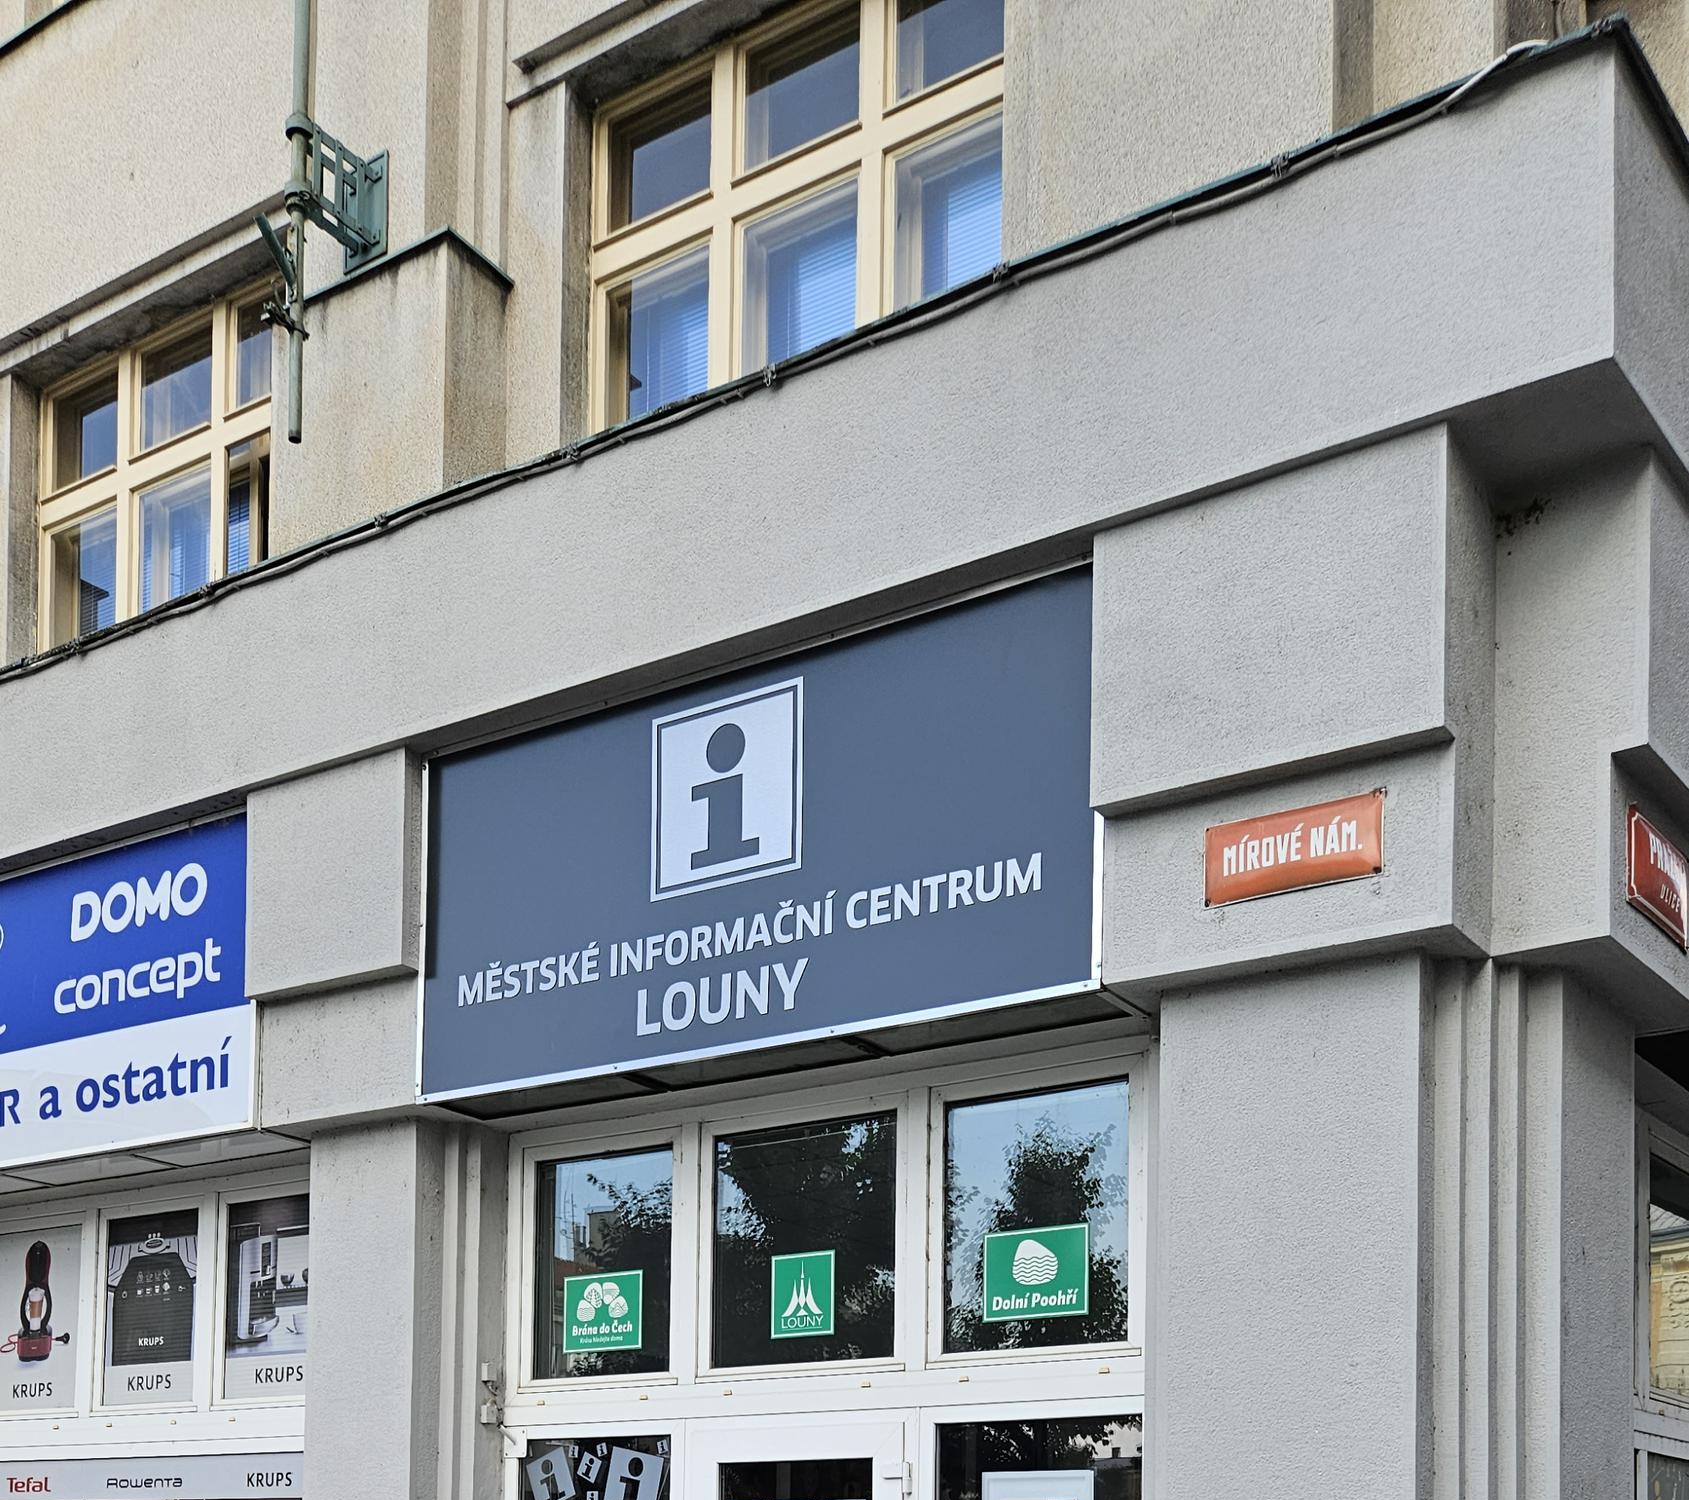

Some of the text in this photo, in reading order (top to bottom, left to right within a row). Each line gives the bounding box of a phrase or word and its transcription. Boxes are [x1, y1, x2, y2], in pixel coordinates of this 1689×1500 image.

[1223, 815, 1363, 877] MÍROVÉ NÁM.
[71, 863, 208, 942] DOMO
[1660, 883, 1680, 912] ULICE
[457, 853, 1043, 1008] MĚSTSKÉ INFORMAČNÍ CENTRUM
[54, 938, 221, 1014] concept
[637, 957, 809, 1036] LOUNY
[39, 1086, 62, 1120] a
[76, 1036, 232, 1113] ostatní
[992, 1288, 1079, 1311] Dolní Poohří
[572, 1319, 633, 1337] Brána do Čech
[781, 1315, 824, 1329] LOUNY
[138, 1336, 164, 1346] KRUPS
[127, 1374, 172, 1391] KRUPS
[255, 1365, 304, 1384] KRUPS
[12, 1382, 53, 1398] KRUPS
[6, 1477, 52, 1493] Tefal
[247, 1472, 293, 1488] KRUPS
